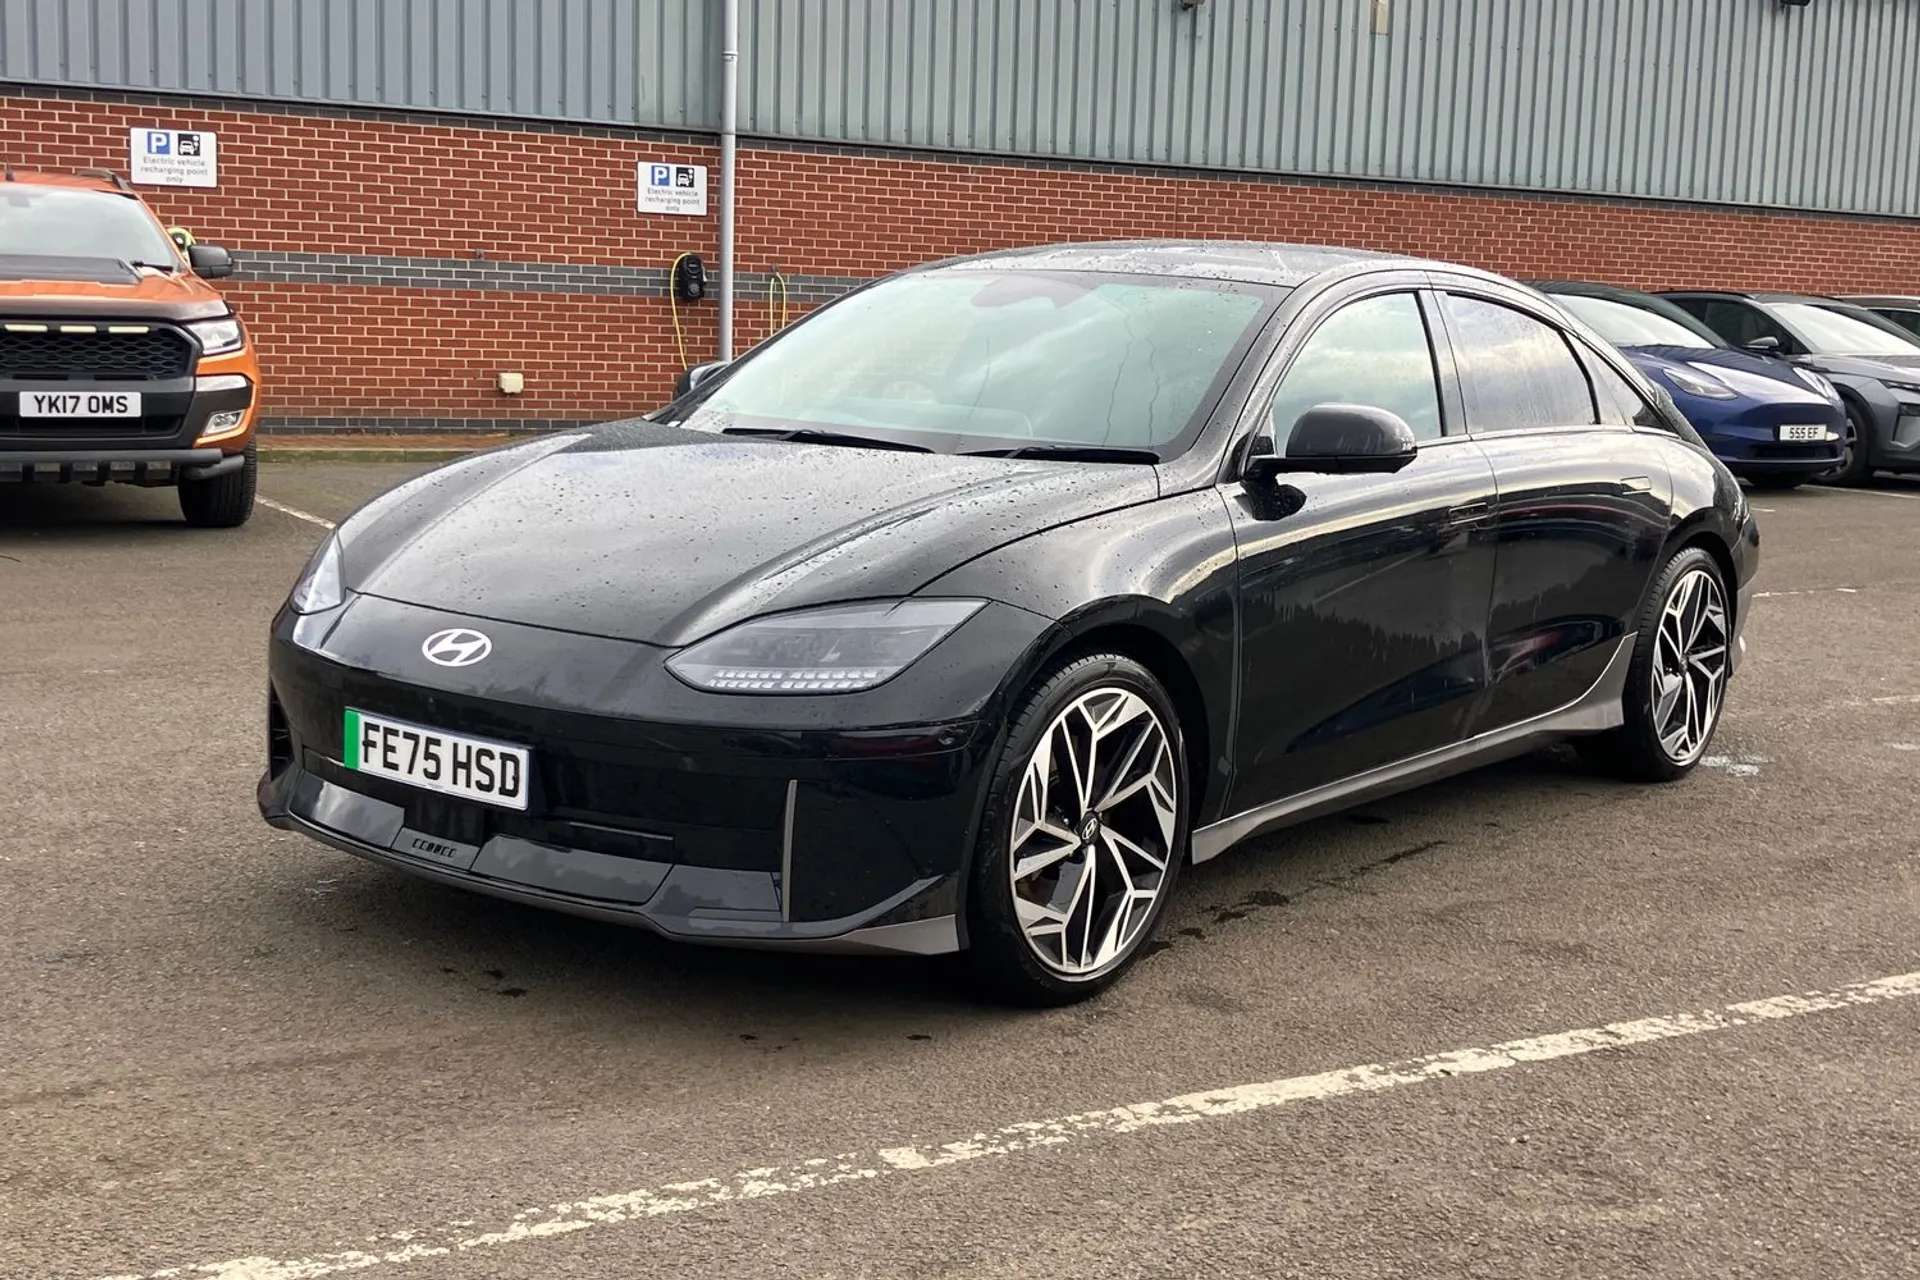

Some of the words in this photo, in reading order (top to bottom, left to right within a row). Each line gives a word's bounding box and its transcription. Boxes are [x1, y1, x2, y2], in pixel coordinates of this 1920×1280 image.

[143, 156, 175, 165] Electric
[177, 158, 206, 167] vehicle
[140, 165, 185, 176] recharging
[186, 167, 208, 176] point
[165, 176, 183, 184] only
[647, 187, 673, 196] Electric
[675, 189, 698, 197] vehicle
[645, 196, 681, 205] recharging
[682, 198, 700, 207] point
[33, 395, 81, 414] YK17
[88, 395, 129, 414] OMS
[1807, 427, 1819, 439] EF
[362, 721, 442, 781] FE75
[452, 741, 521, 799] HSD
